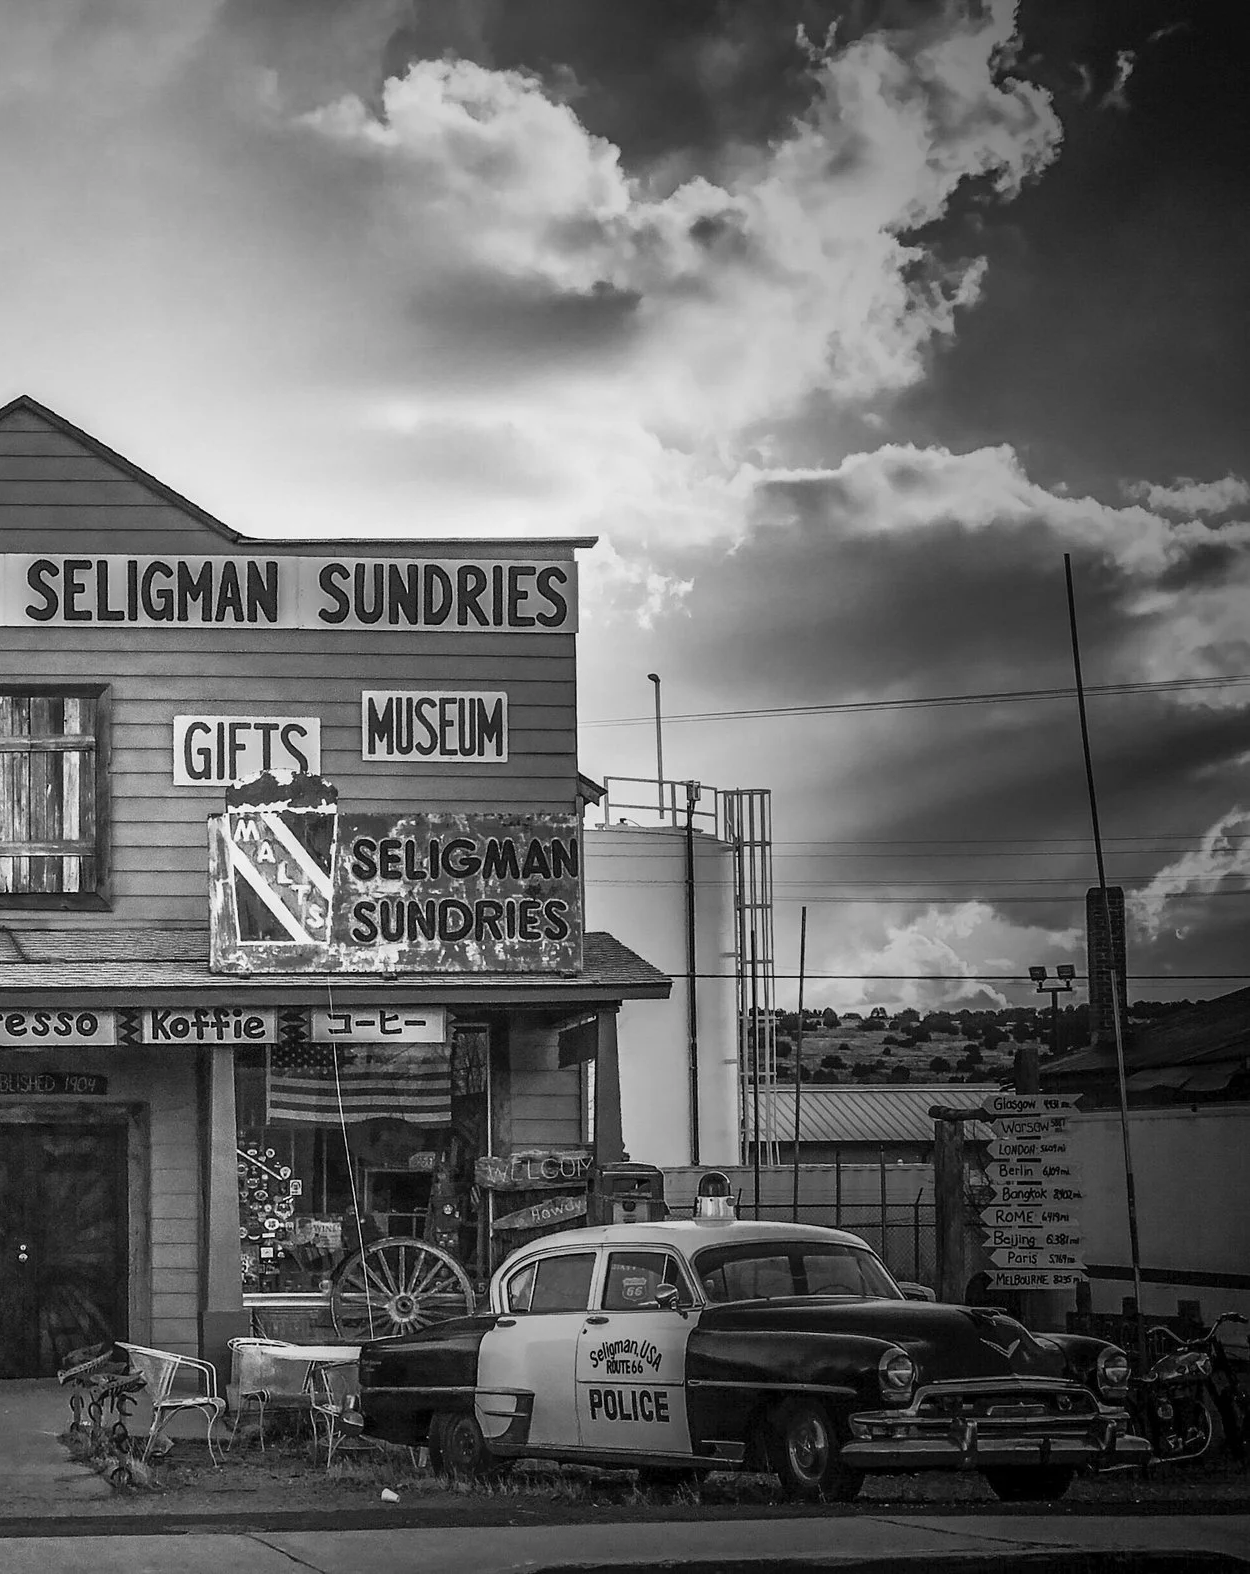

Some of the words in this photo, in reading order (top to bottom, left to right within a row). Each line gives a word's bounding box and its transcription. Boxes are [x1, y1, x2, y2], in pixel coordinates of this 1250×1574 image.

[26, 560, 278, 624] SELIGMAN
[318, 562, 568, 627] SUNDRIES
[367, 695, 504, 758] MUSEUM
[183, 720, 310, 782] GIFTS
[350, 837, 580, 881] SELIGMAN
[232, 818, 327, 930] MALTS
[351, 898, 571, 944] SUNDRIES
[150, 1008, 267, 1041] Koffie
[327, 1010, 427, 1036] コーヒー
[64, 1076, 96, 1093] 1904
[993, 1097, 1037, 1113] Glasgow
[1001, 1120, 1050, 1134] Warsaw
[487, 1156, 595, 1183] WELCOM
[999, 1163, 1034, 1178] Berlin
[1002, 1186, 1048, 1203] Bangkok
[530, 1199, 582, 1222] Howdy
[995, 1210, 1035, 1224] ROME
[993, 1231, 1036, 1248] Beijing
[1007, 1251, 1038, 1264] Paris
[996, 1273, 1051, 1286] MELBOURNE
[625, 1285, 644, 1298] 66
[589, 1338, 638, 1369] Seligman,
[639, 1339, 663, 1373] USA
[606, 1359, 631, 1375] ROUTE
[631, 1360, 644, 1375] 66
[588, 1388, 671, 1423] POLICE
